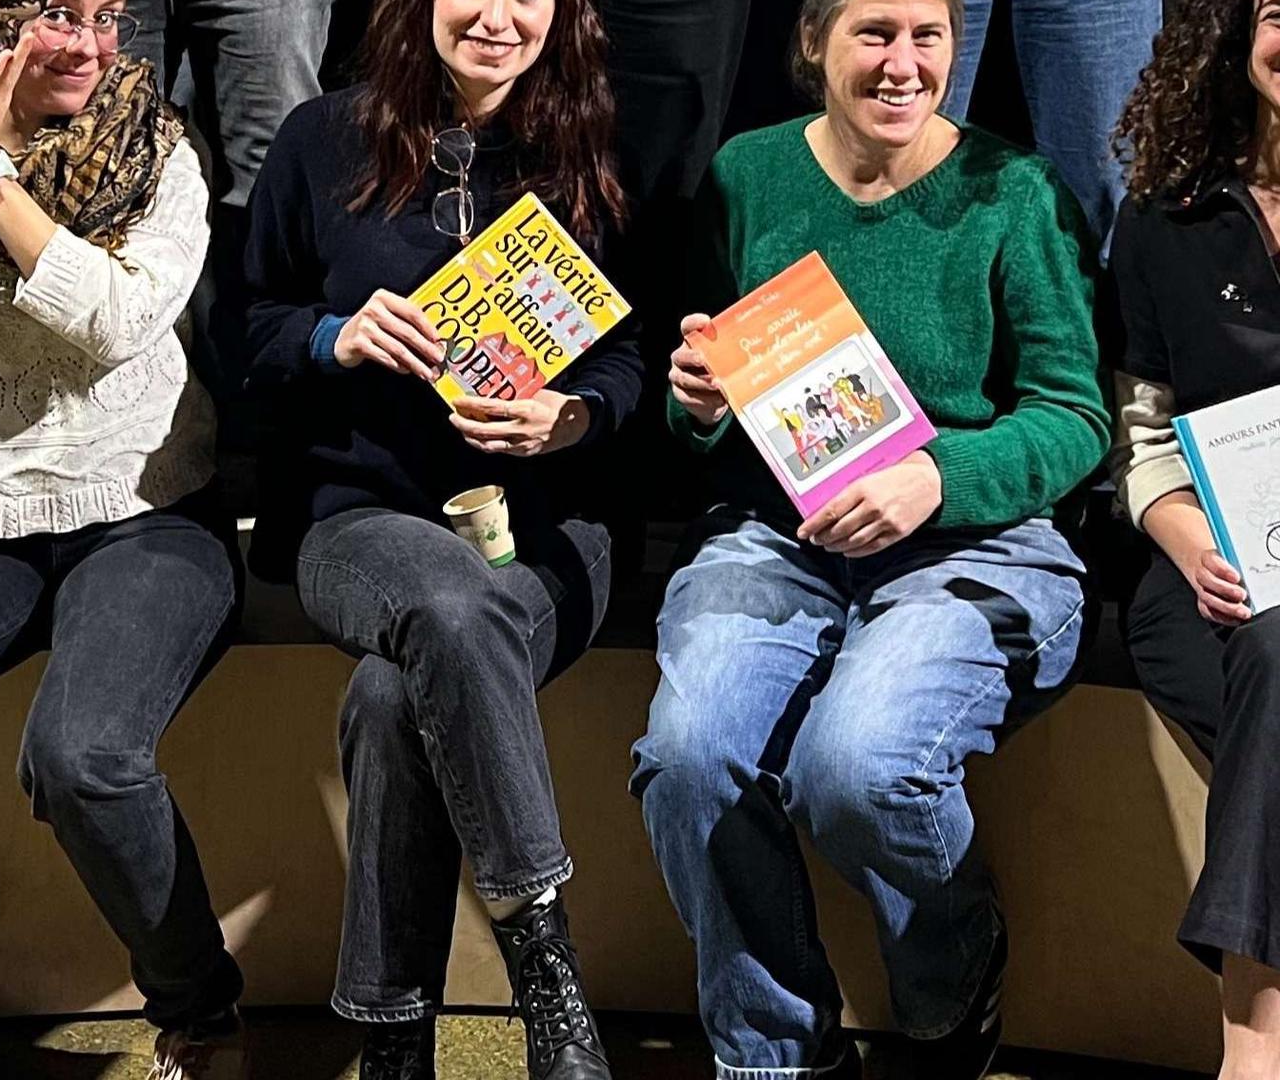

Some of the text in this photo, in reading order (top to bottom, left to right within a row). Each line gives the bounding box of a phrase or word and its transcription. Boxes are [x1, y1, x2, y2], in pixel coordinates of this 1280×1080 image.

[496, 233, 538, 274] sur
[515, 209, 548, 252] La
[544, 245, 611, 316] vérité
[484, 269, 563, 365] l'affaire
[1208, 427, 1256, 448] AMOURS
